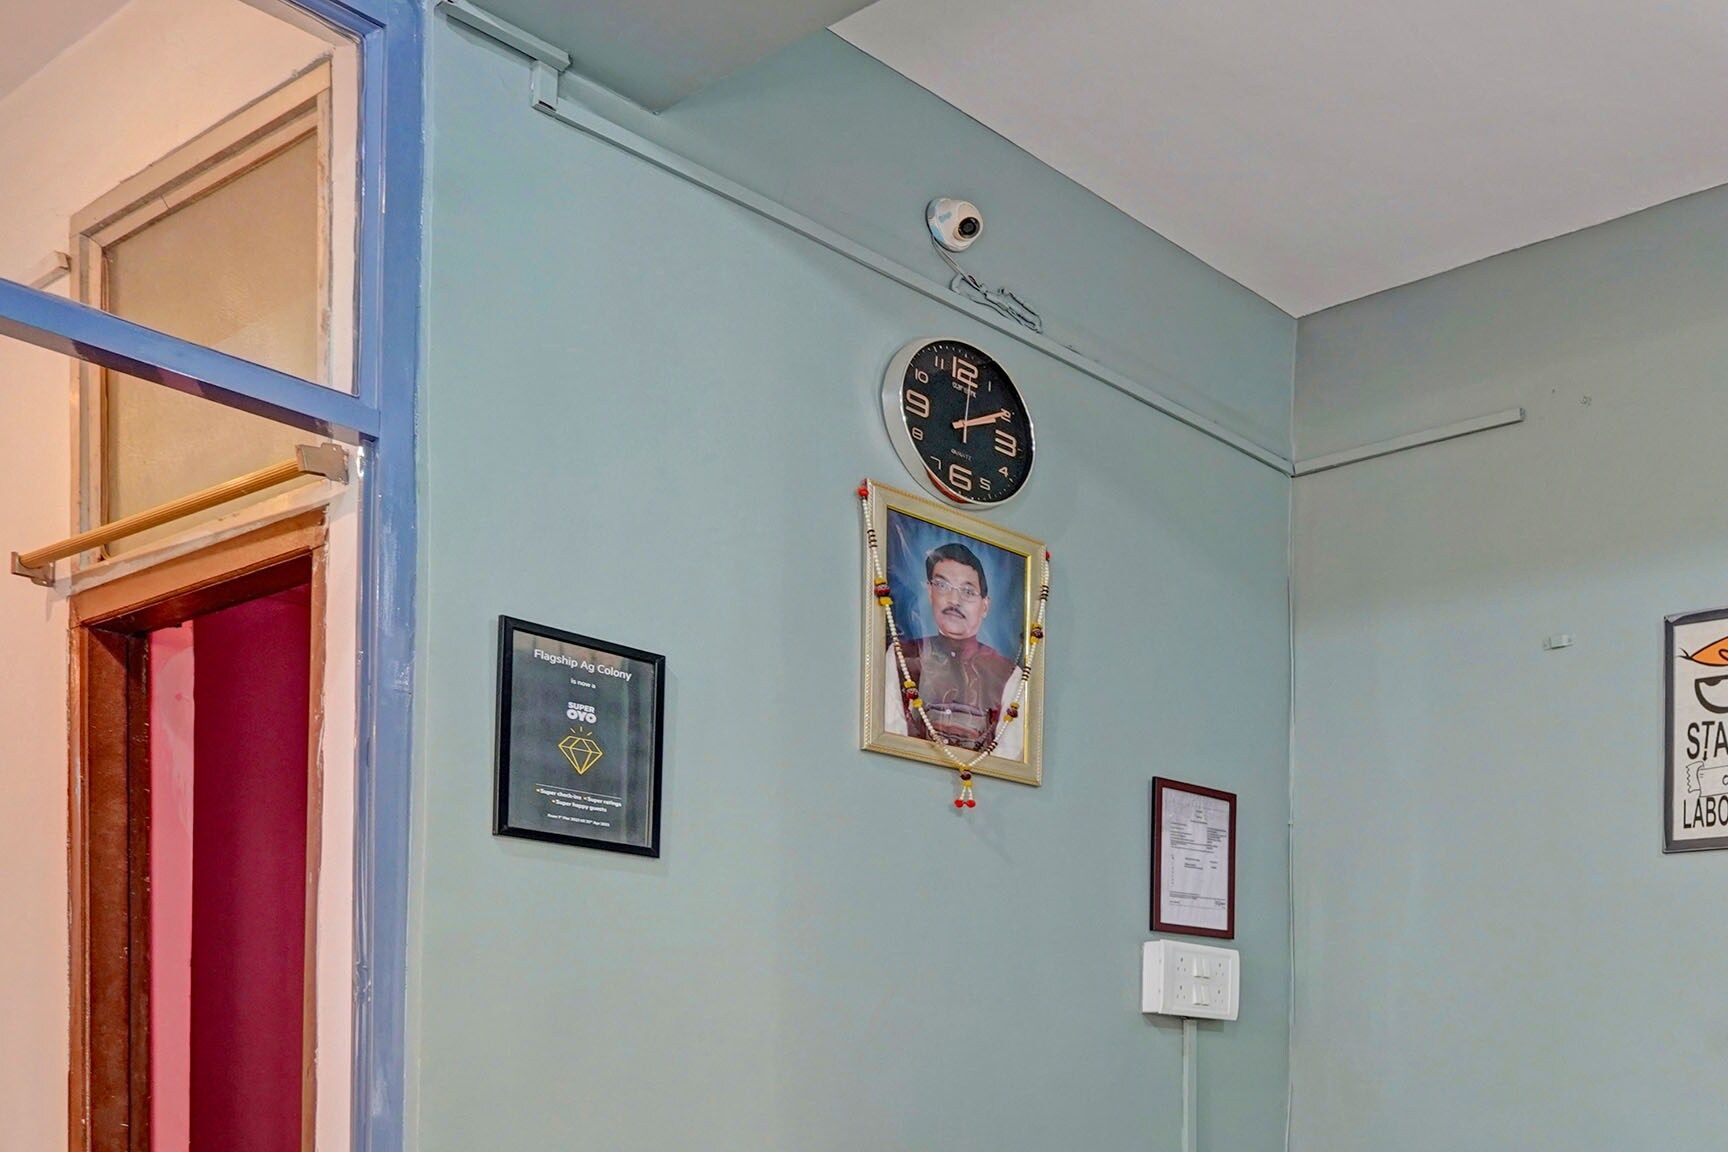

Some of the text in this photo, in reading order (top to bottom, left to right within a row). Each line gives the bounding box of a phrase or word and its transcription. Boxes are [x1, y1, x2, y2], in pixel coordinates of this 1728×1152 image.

[935, 356, 944, 369] 11
[915, 368, 929, 384] 10
[952, 356, 978, 389] 12
[905, 389, 930, 418] 9
[912, 427, 923, 441] 8
[994, 429, 1017, 458] 3
[930, 455, 942, 471] 7
[949, 463, 972, 492] 6
[998, 466, 1009, 478] 4
[979, 477, 991, 491] 5
[534, 648, 632, 681] Flagship Ag Colony
[567, 701, 595, 713] SUPER
[566, 708, 597, 724] OYO
